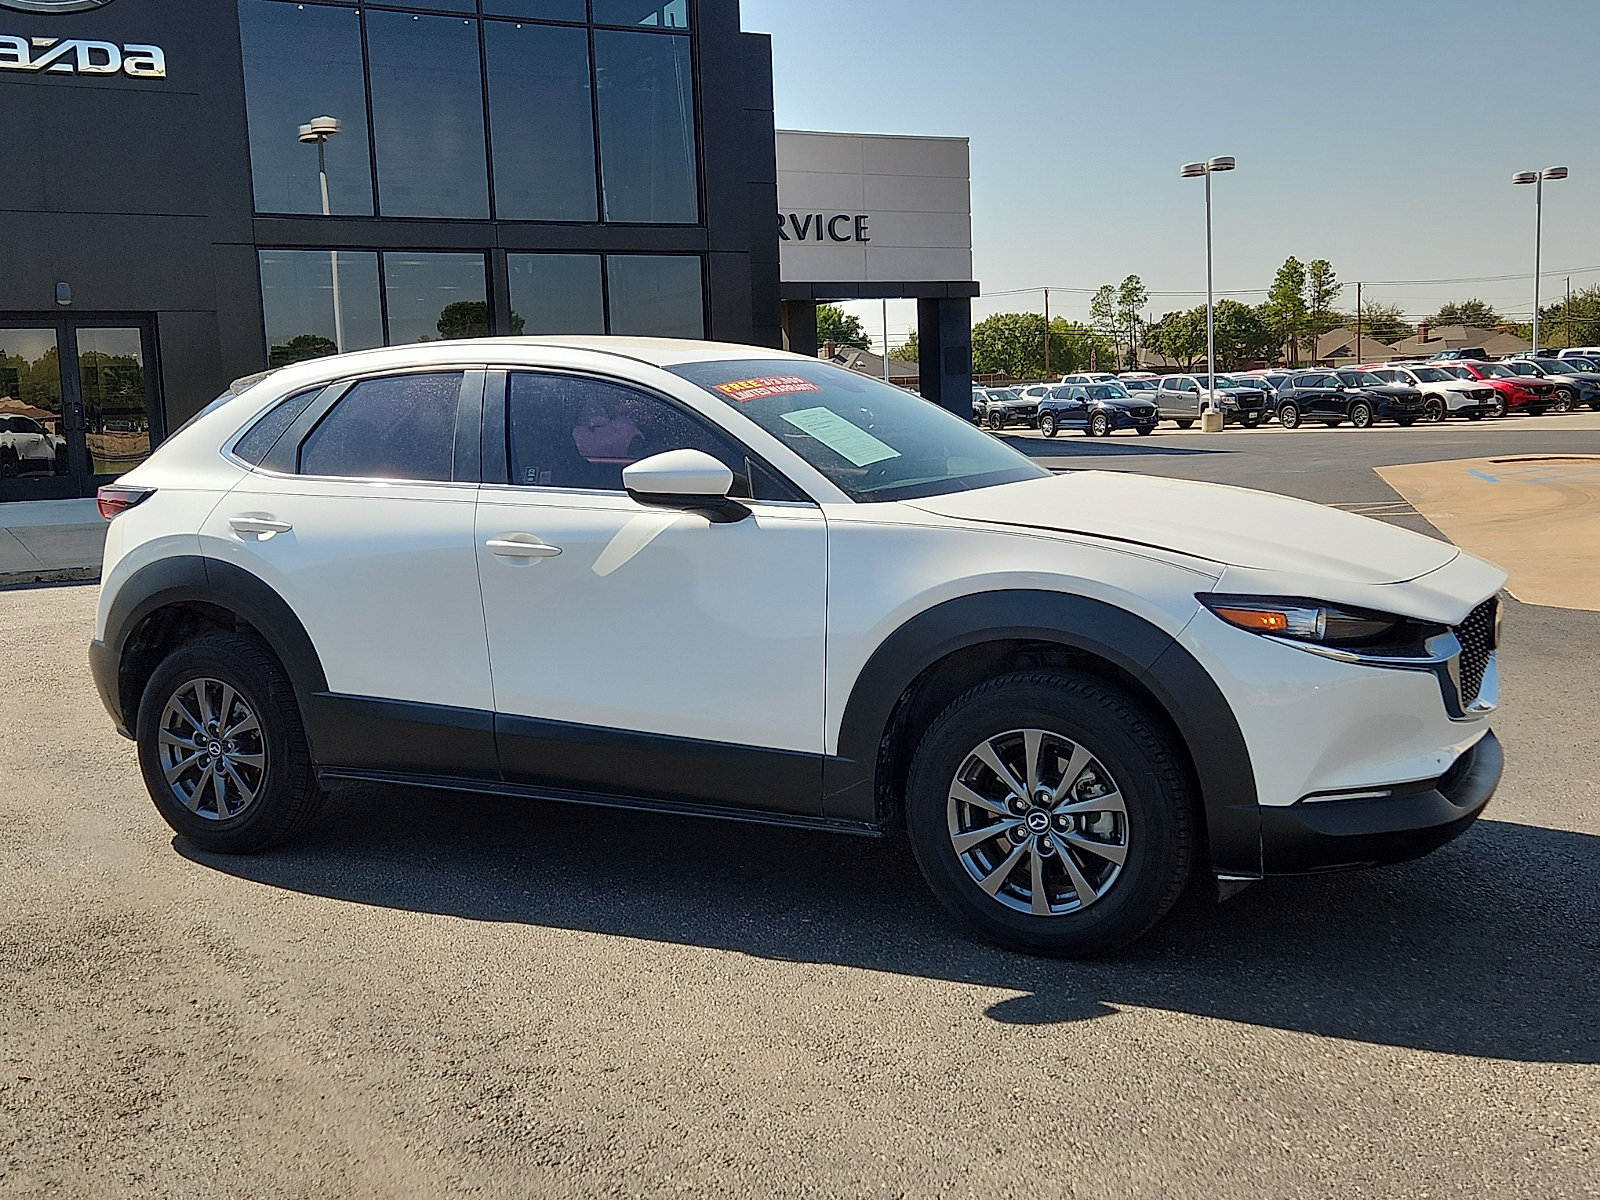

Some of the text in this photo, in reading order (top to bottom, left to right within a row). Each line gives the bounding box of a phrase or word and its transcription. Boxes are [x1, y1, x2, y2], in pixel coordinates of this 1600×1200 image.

[719, 380, 762, 393] FREE
[731, 383, 819, 401] LIMITED WARRANTY
